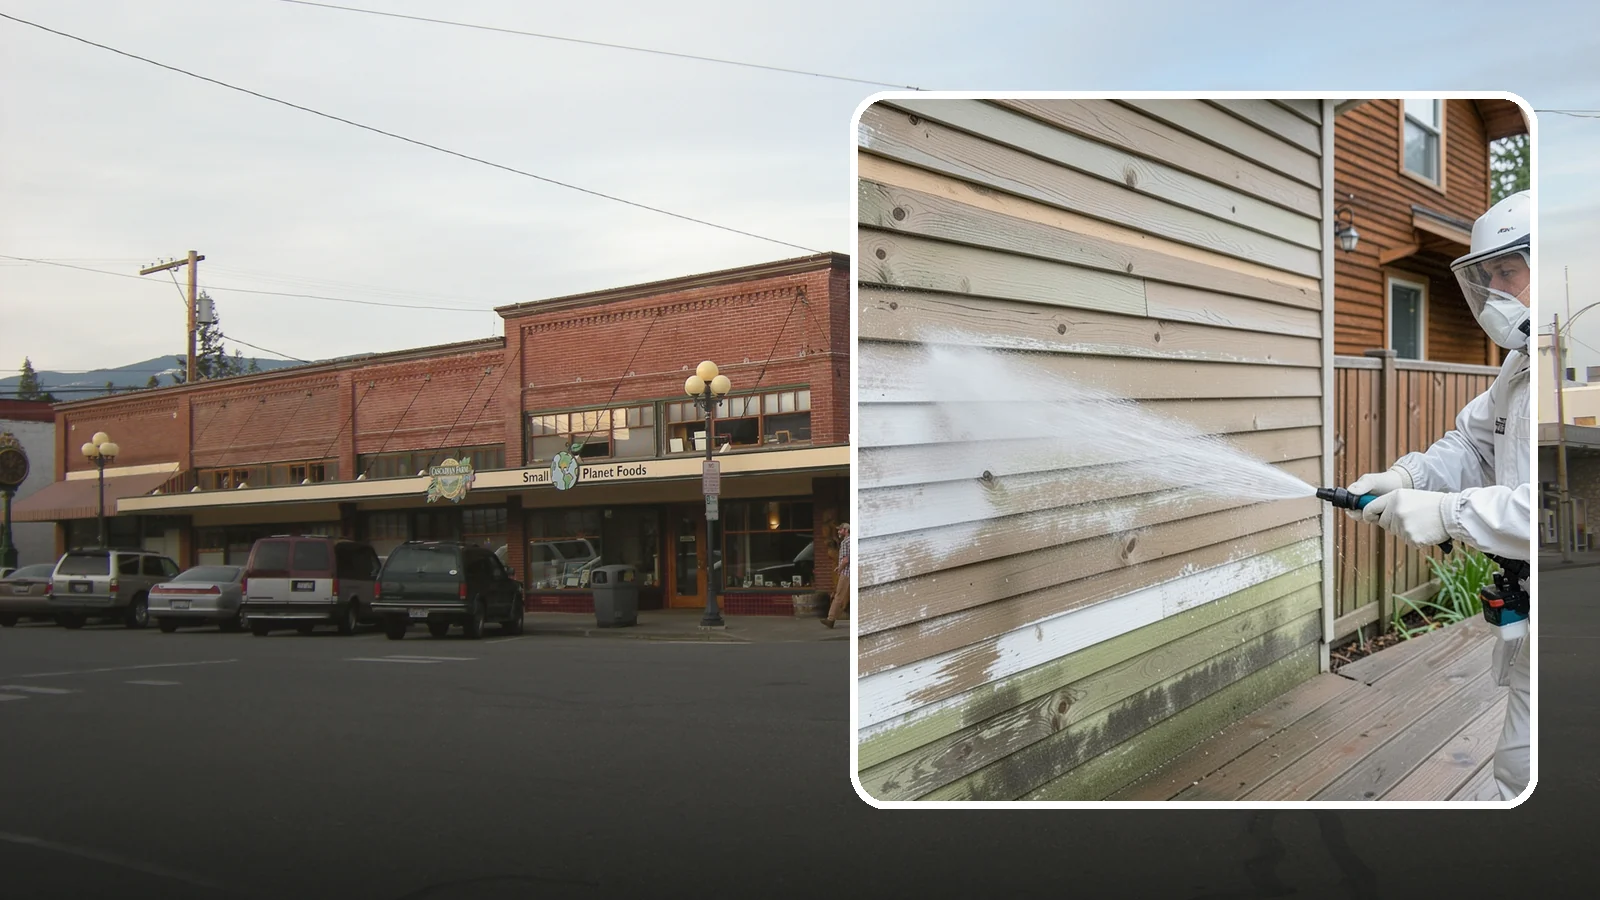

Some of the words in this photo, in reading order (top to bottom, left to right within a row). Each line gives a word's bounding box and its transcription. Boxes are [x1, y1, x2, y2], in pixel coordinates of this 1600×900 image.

[523, 471, 549, 482] Small
[583, 467, 614, 479] Planet
[617, 464, 647, 477] Foods
